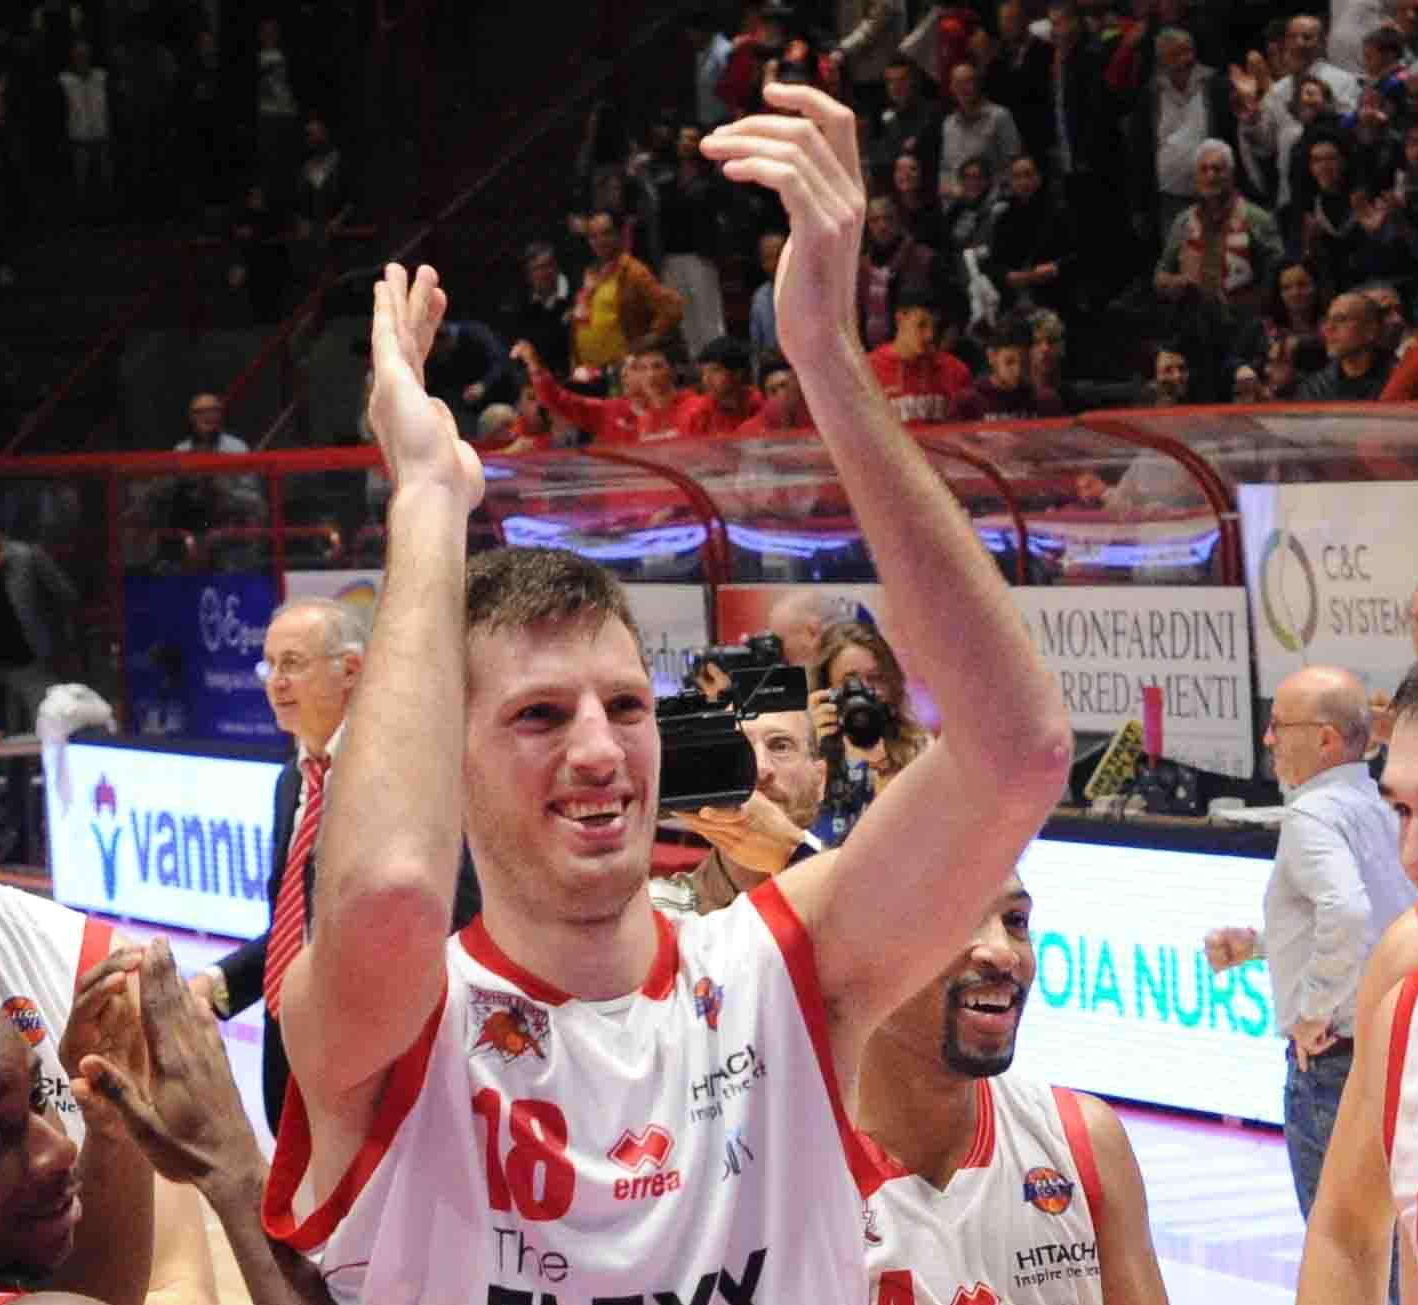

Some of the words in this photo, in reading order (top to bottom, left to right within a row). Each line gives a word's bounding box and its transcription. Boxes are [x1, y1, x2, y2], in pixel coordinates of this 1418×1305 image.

[1321, 544, 1372, 581] C&C
[1039, 608, 1238, 665] MONFARDINI
[1037, 929, 1127, 1018] OIA
[470, 1087, 576, 1221] 18
[612, 1168, 681, 1202] errea
[492, 1226, 569, 1284] The
